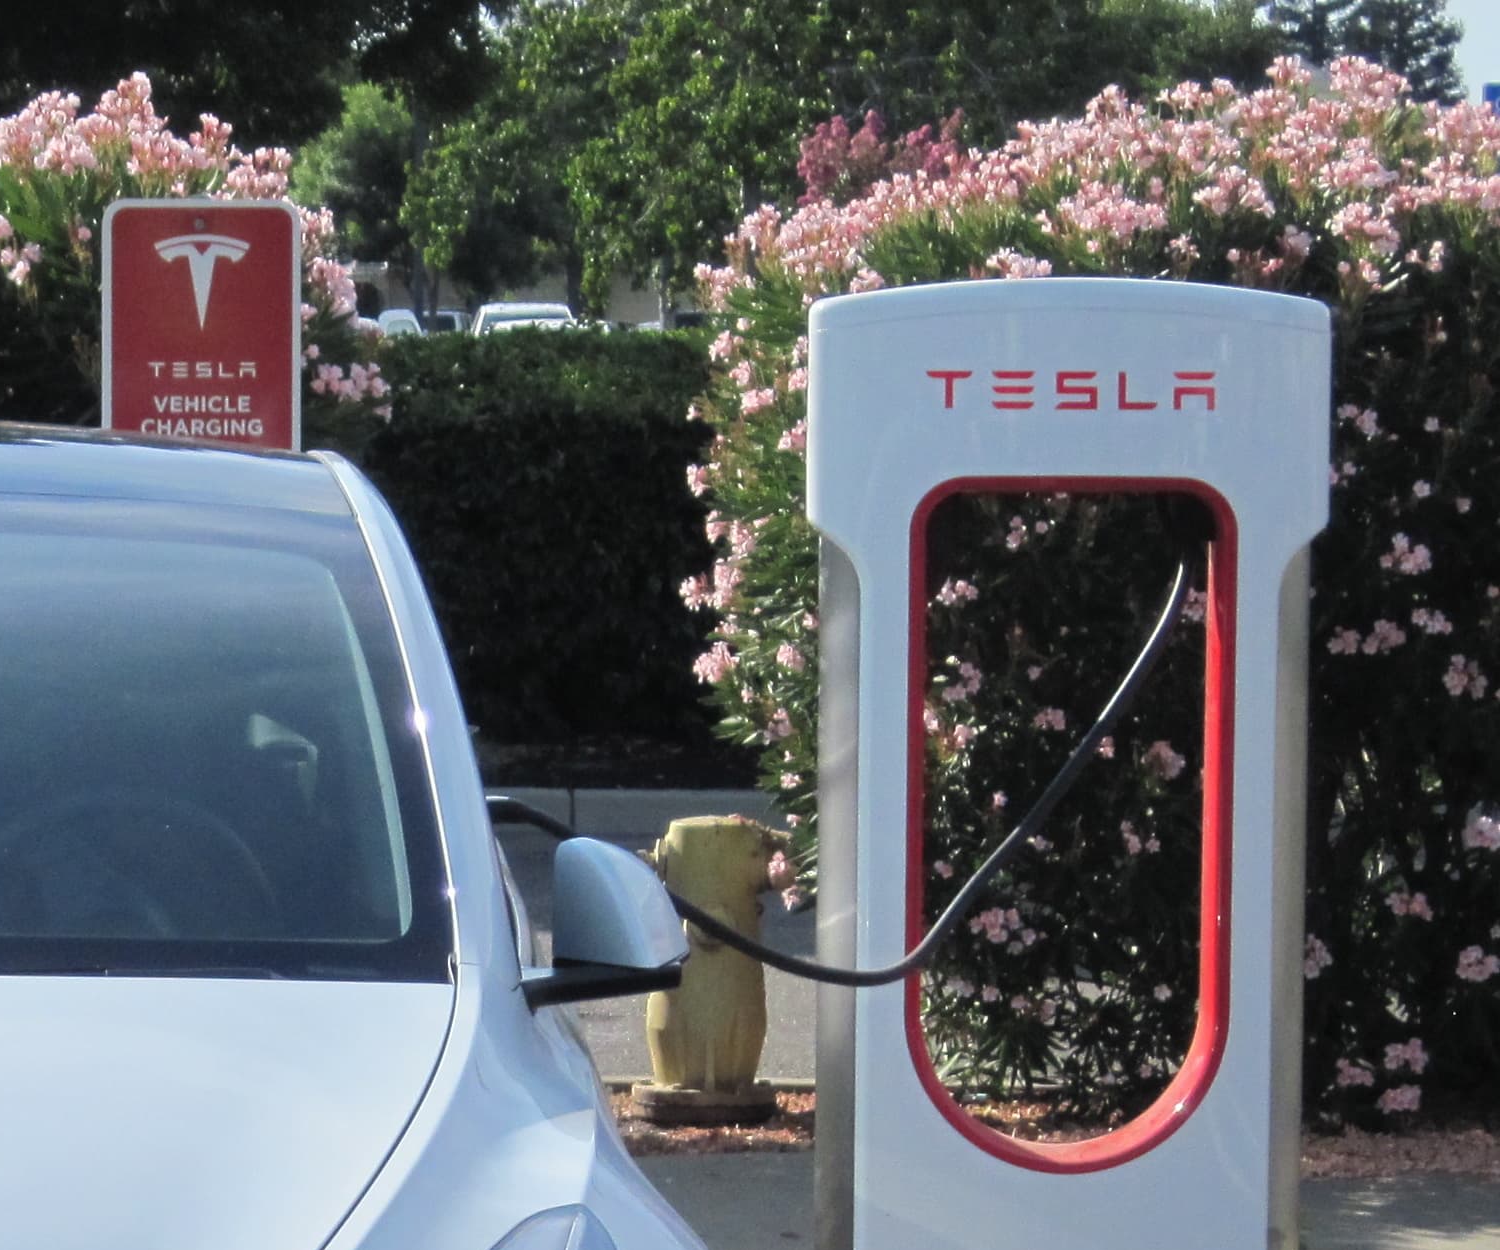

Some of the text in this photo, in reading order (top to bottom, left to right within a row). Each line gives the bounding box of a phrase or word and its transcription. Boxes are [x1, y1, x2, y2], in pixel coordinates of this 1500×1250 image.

[148, 362, 256, 378] TESLA
[926, 370, 1216, 411] TESLA
[154, 395, 251, 413] VEHICLE
[141, 419, 264, 436] CHARGING
